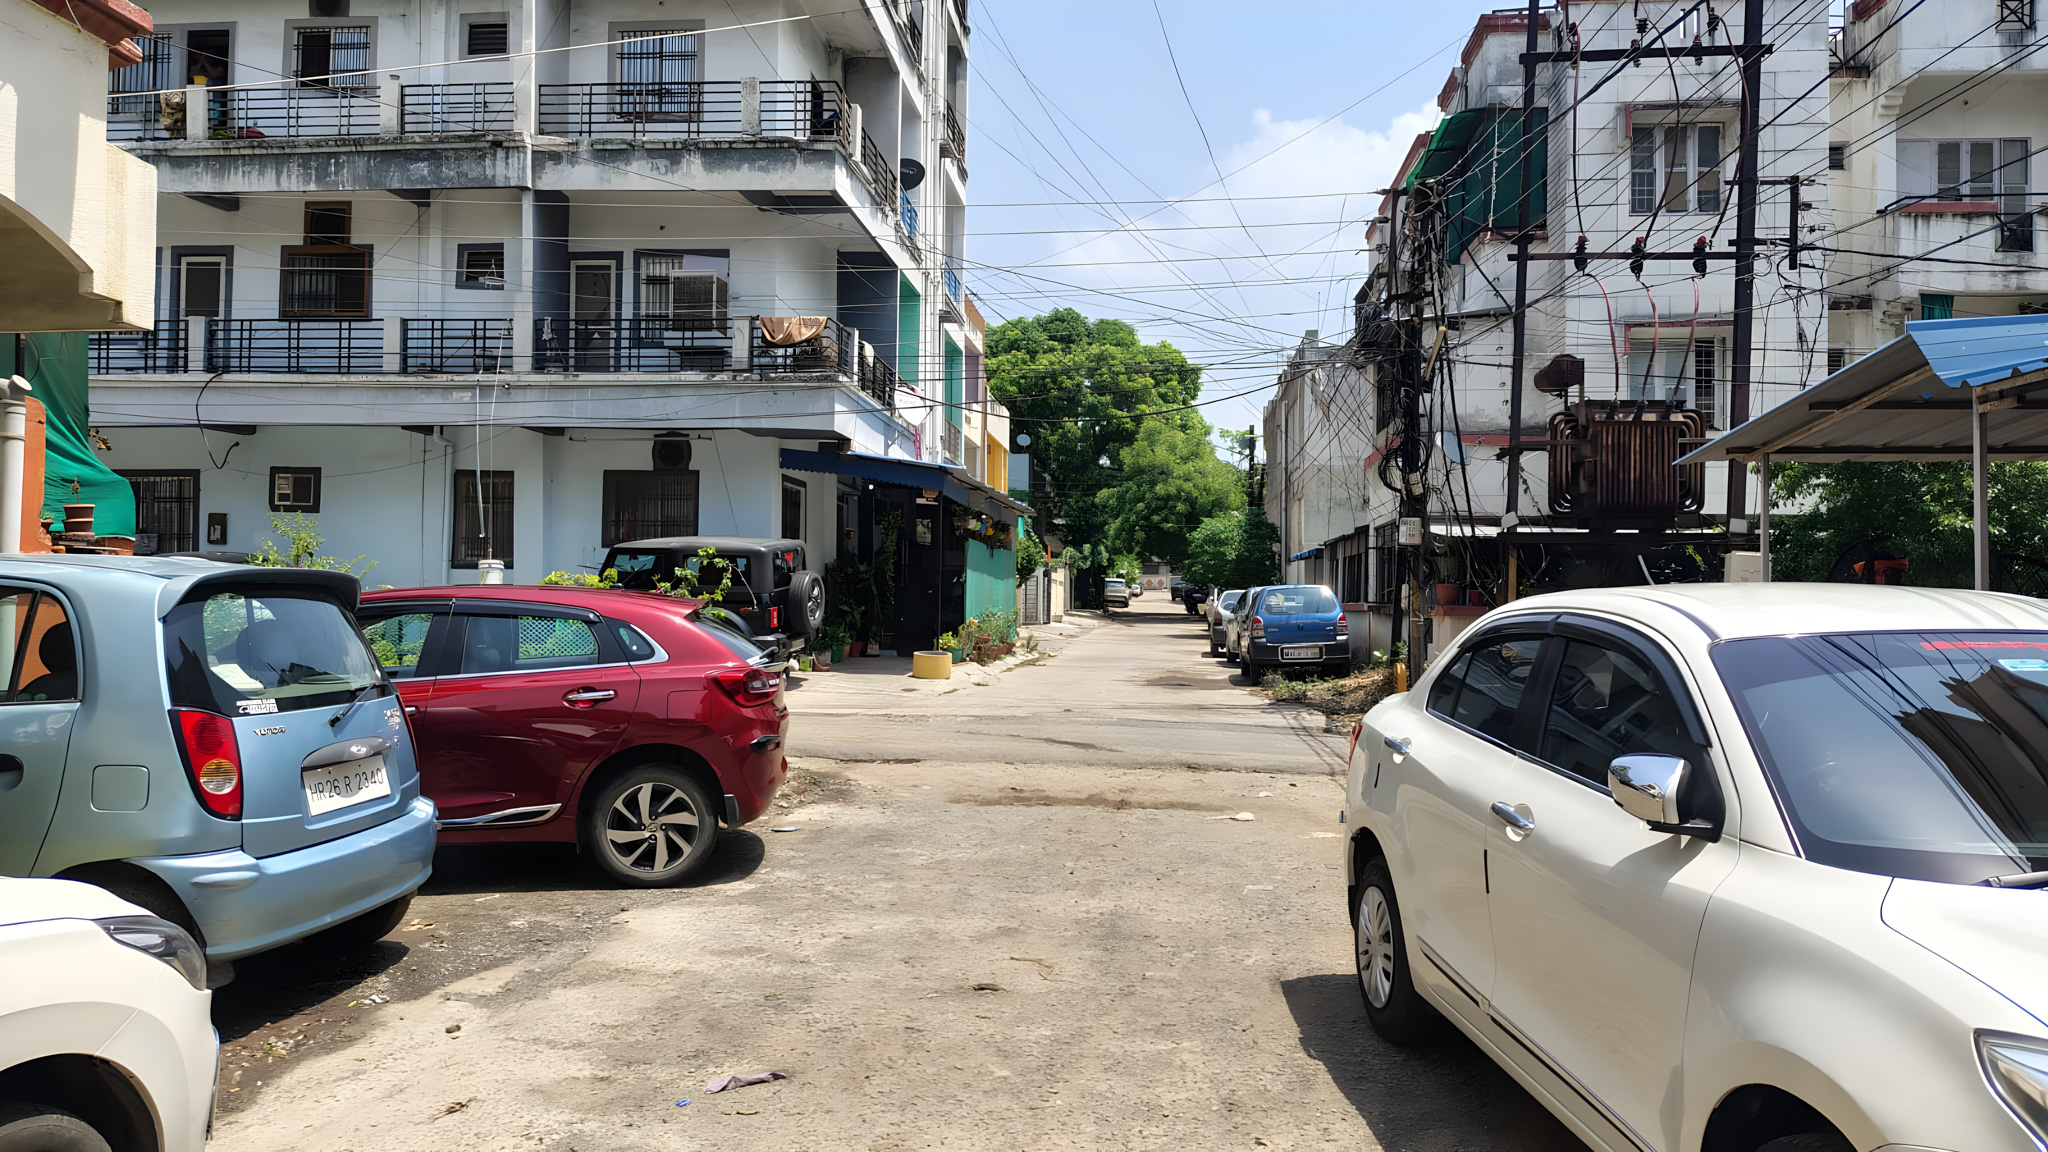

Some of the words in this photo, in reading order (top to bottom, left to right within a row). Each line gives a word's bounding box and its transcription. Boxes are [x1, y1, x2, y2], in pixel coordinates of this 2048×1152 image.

[309, 778, 341, 802] HR26
[343, 775, 353, 793] R
[354, 767, 384, 791] 2340
